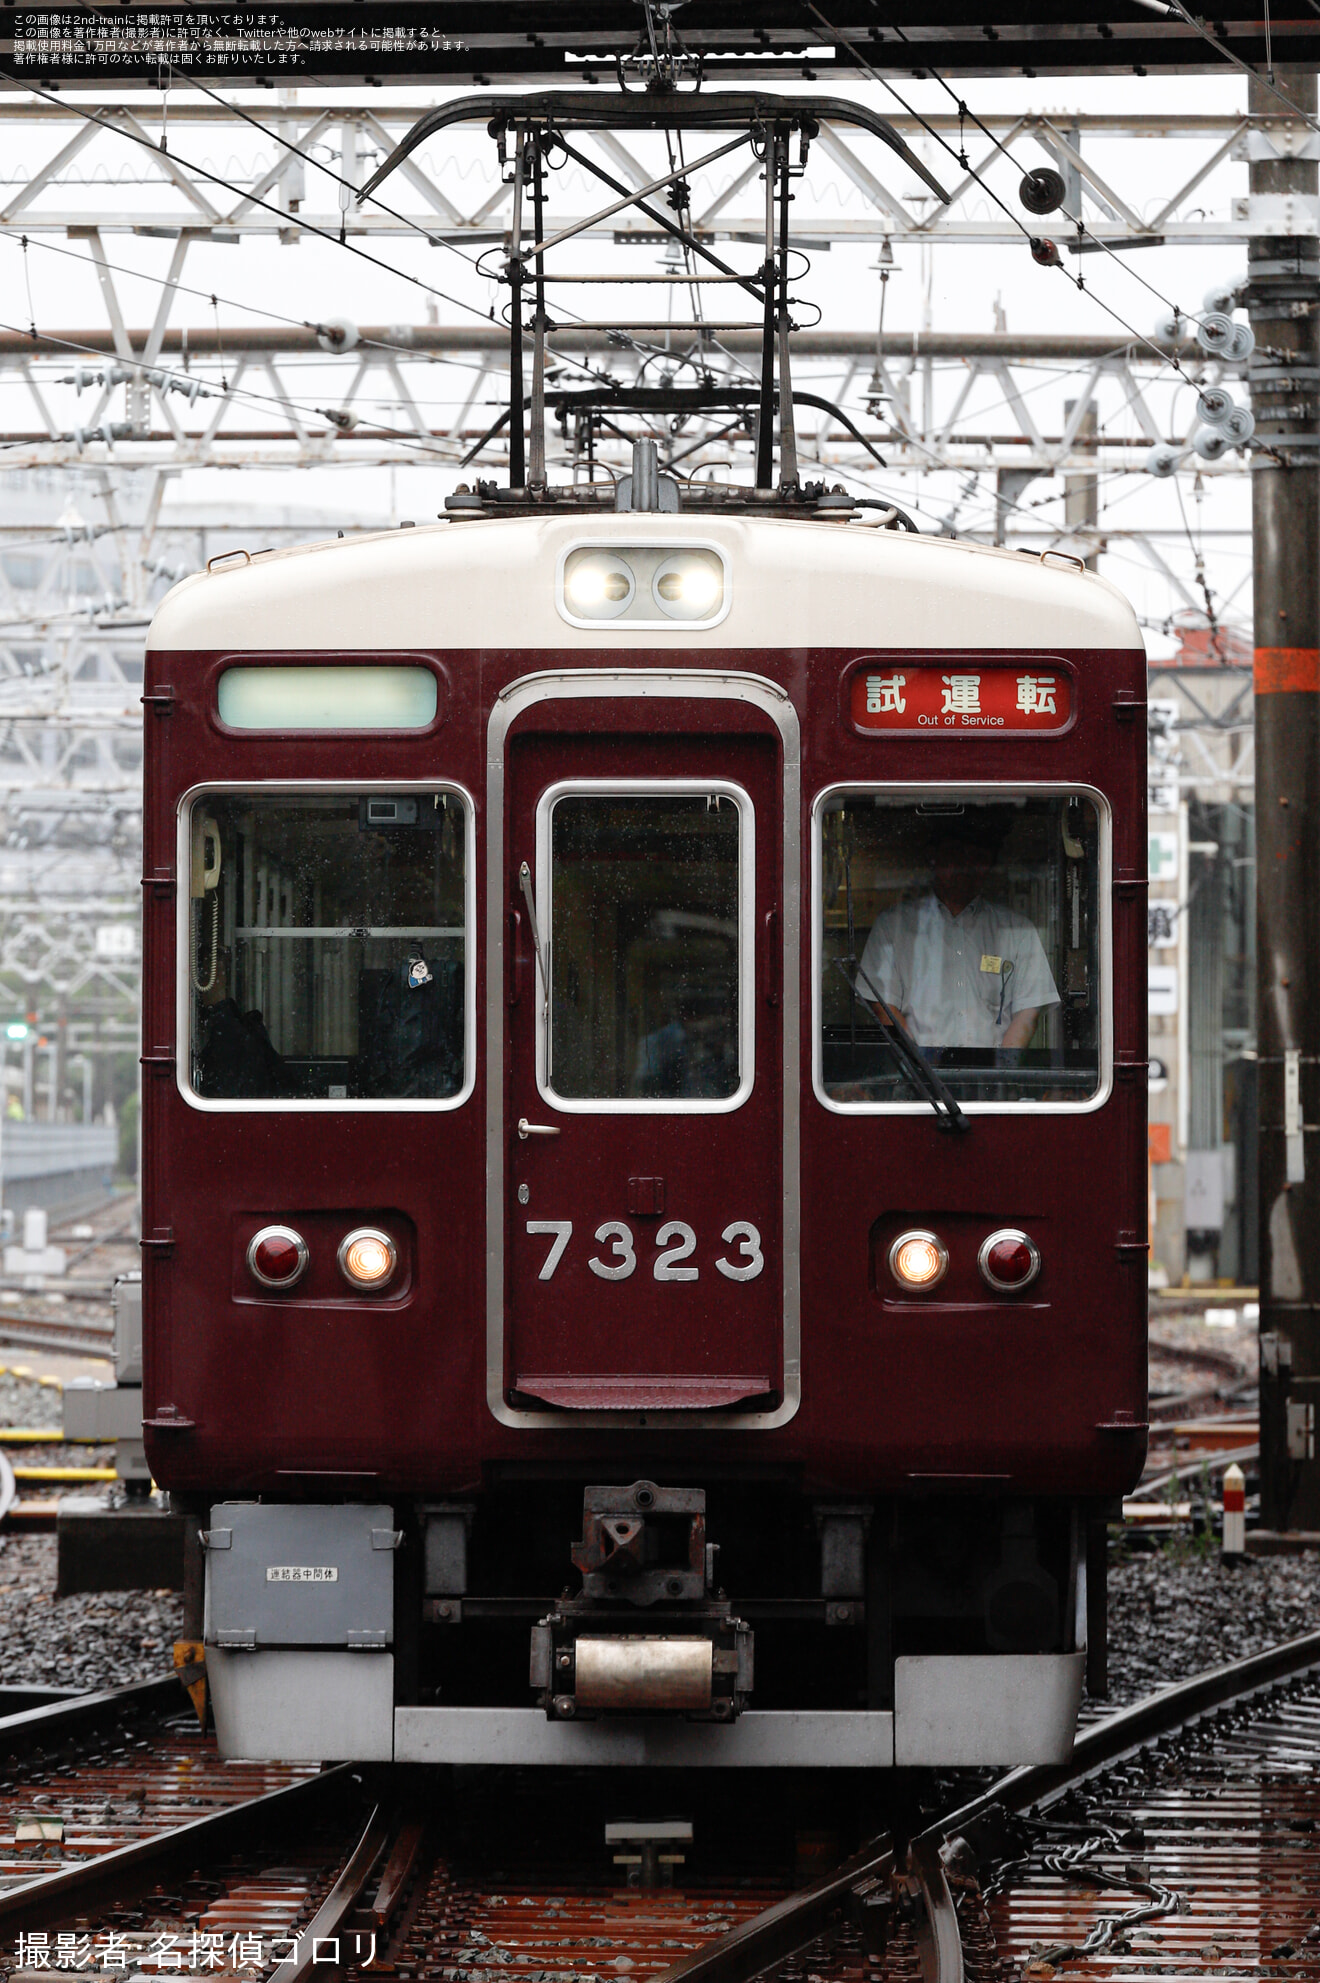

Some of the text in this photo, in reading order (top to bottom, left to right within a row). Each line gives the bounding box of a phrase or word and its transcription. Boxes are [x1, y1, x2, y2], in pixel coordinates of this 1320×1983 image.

[865, 674, 1057, 715] 試運転
[917, 714, 1005, 726] Out of Service
[526, 1220, 765, 1282] 7323
[270, 1567, 334, 1580] 連結器中間体
